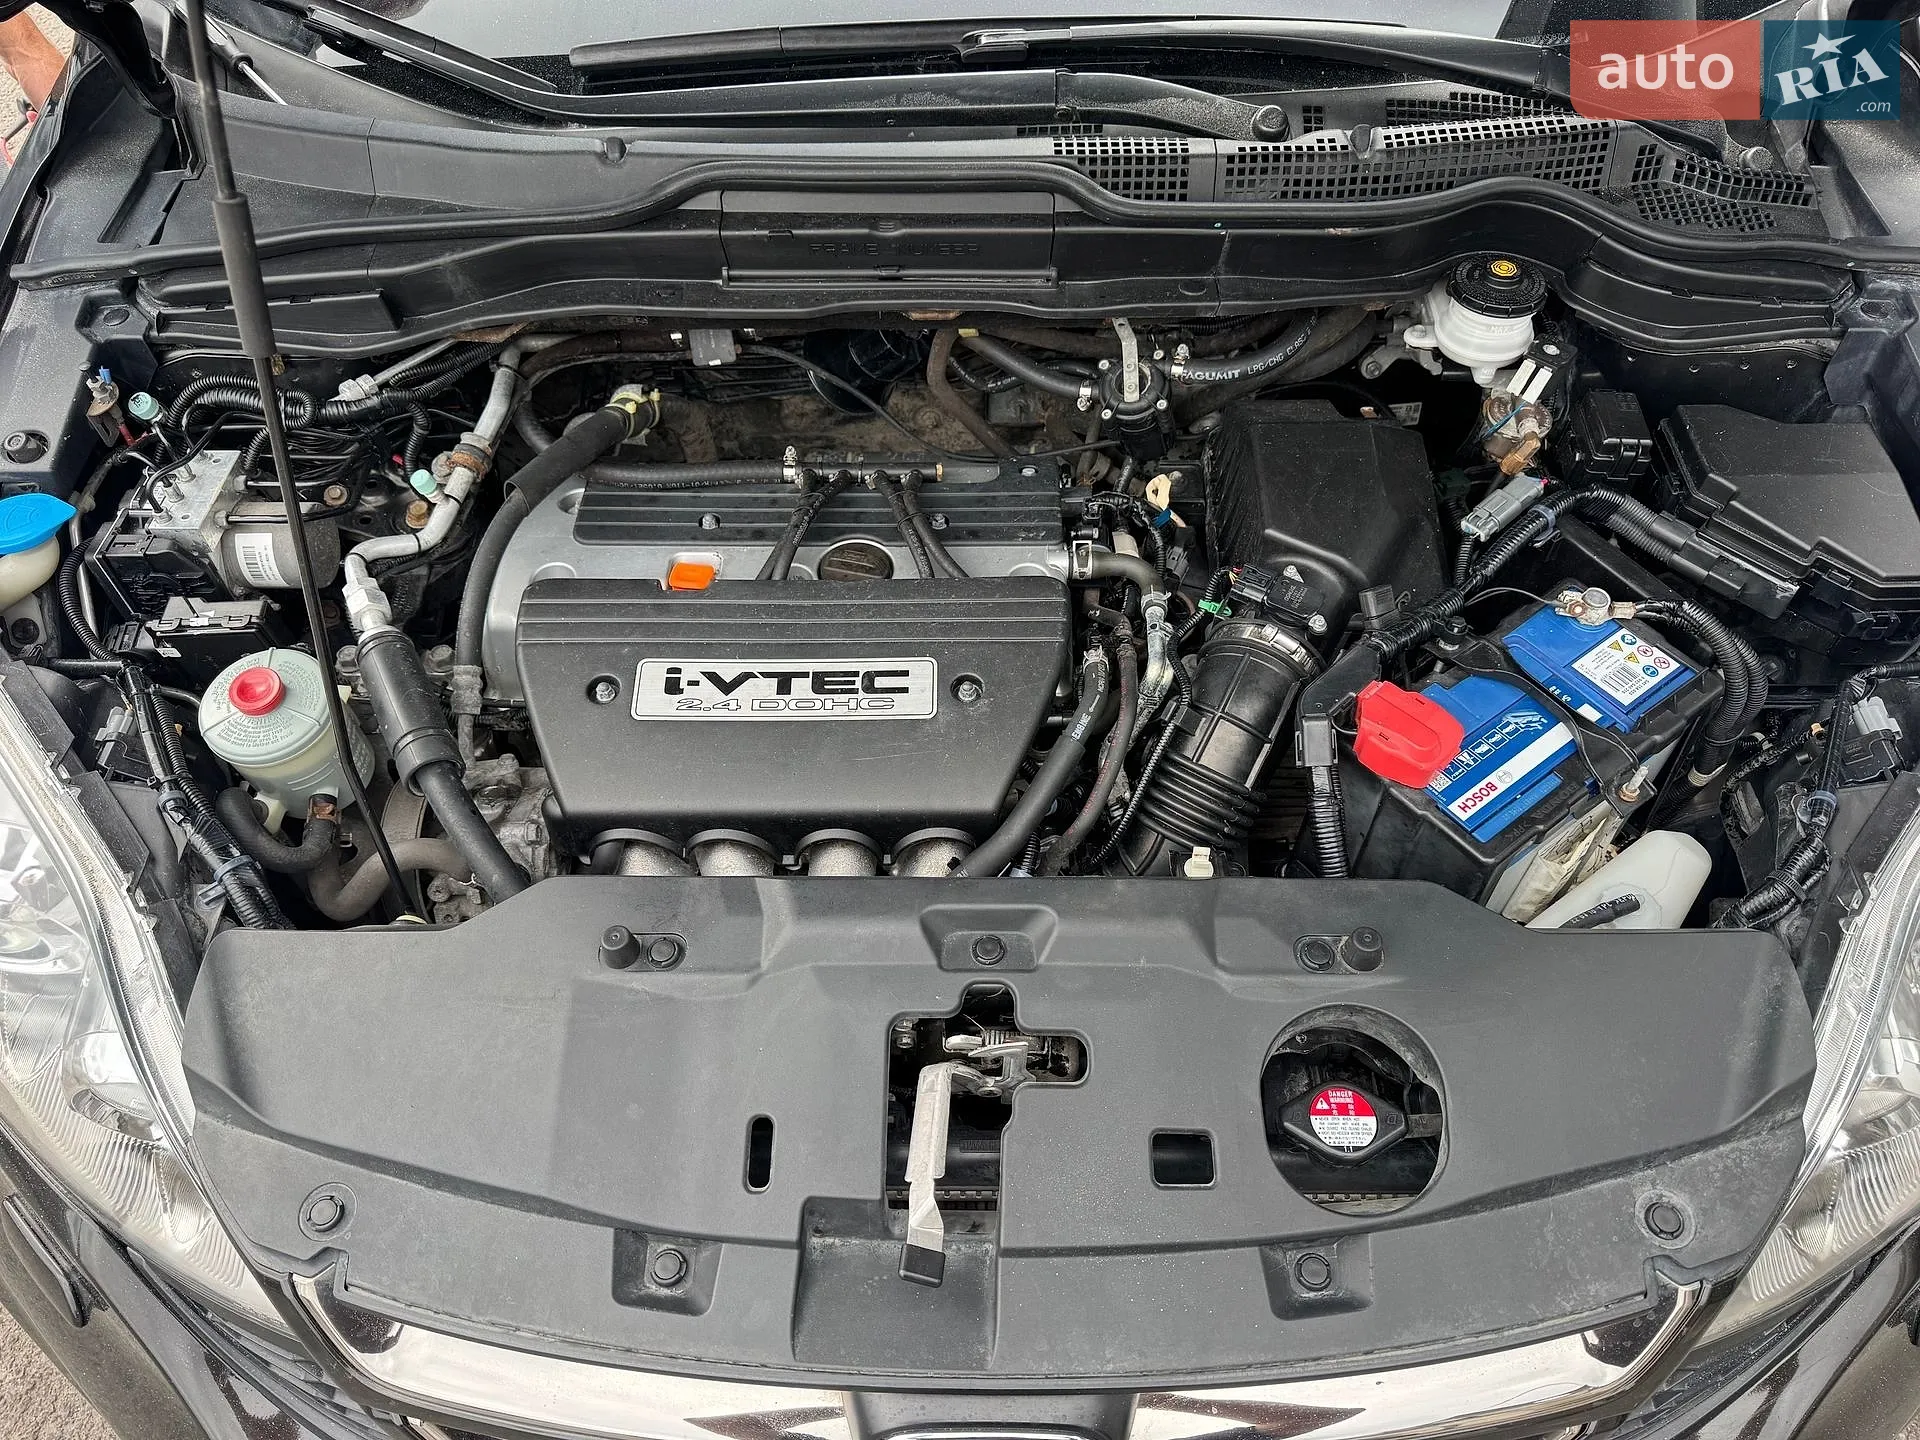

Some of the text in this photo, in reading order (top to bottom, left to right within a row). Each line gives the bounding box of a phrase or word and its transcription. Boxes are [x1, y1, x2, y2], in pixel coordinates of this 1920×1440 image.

[663, 666, 910, 697] i-VTEC
[676, 697, 895, 712] 2.4 DOHC
[1457, 781, 1499, 815] BOSCH
